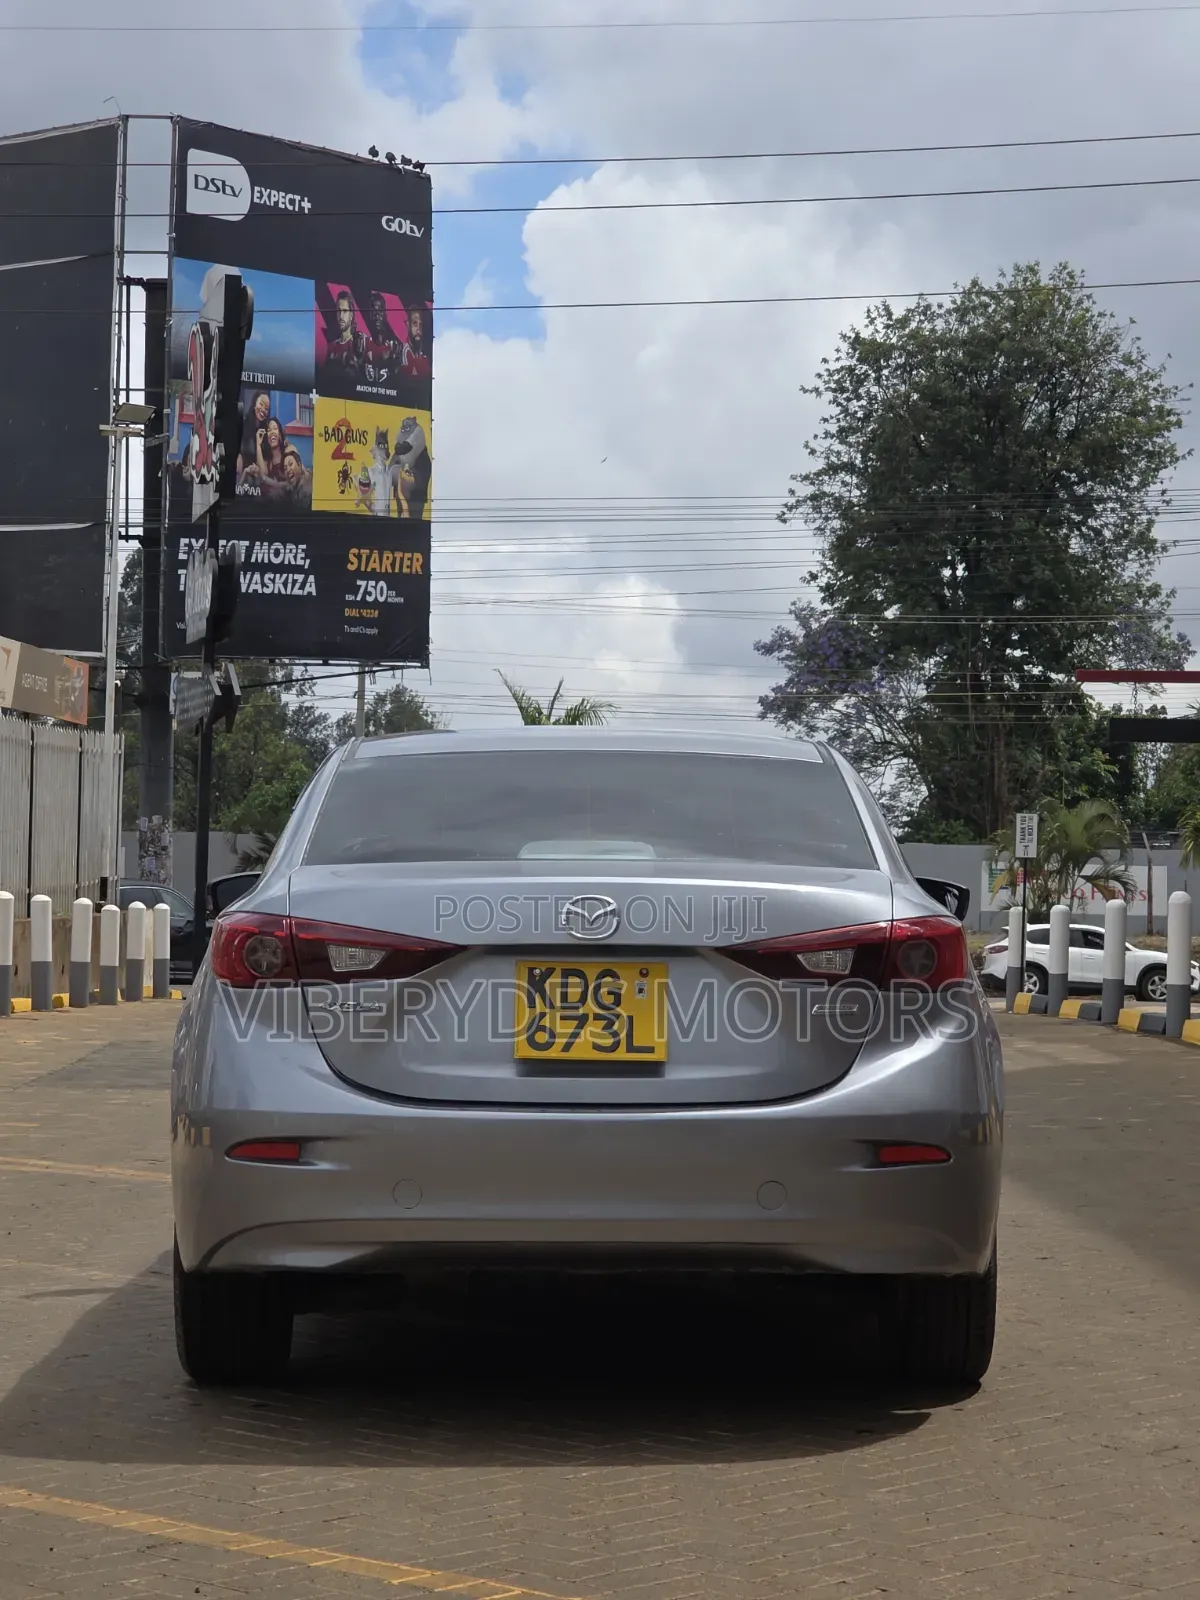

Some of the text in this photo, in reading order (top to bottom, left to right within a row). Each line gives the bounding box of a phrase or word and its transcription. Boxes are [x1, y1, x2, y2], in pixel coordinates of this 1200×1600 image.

[194, 173, 242, 198] DStv
[253, 185, 311, 214] EXPECT+
[381, 215, 424, 238] GOtv
[356, 384, 371, 392] MATCH
[377, 387, 385, 395] THE
[385, 388, 397, 396] WEEK
[324, 426, 343, 443] BAD
[345, 427, 368, 446] GUYS
[331, 417, 356, 461] 2
[250, 541, 310, 569] MORE,
[346, 547, 423, 575] STARTER
[356, 579, 387, 602] 750
[344, 607, 360, 617] DIAL
[526, 966, 622, 1011] KDG
[525, 1011, 655, 1054] 673L
